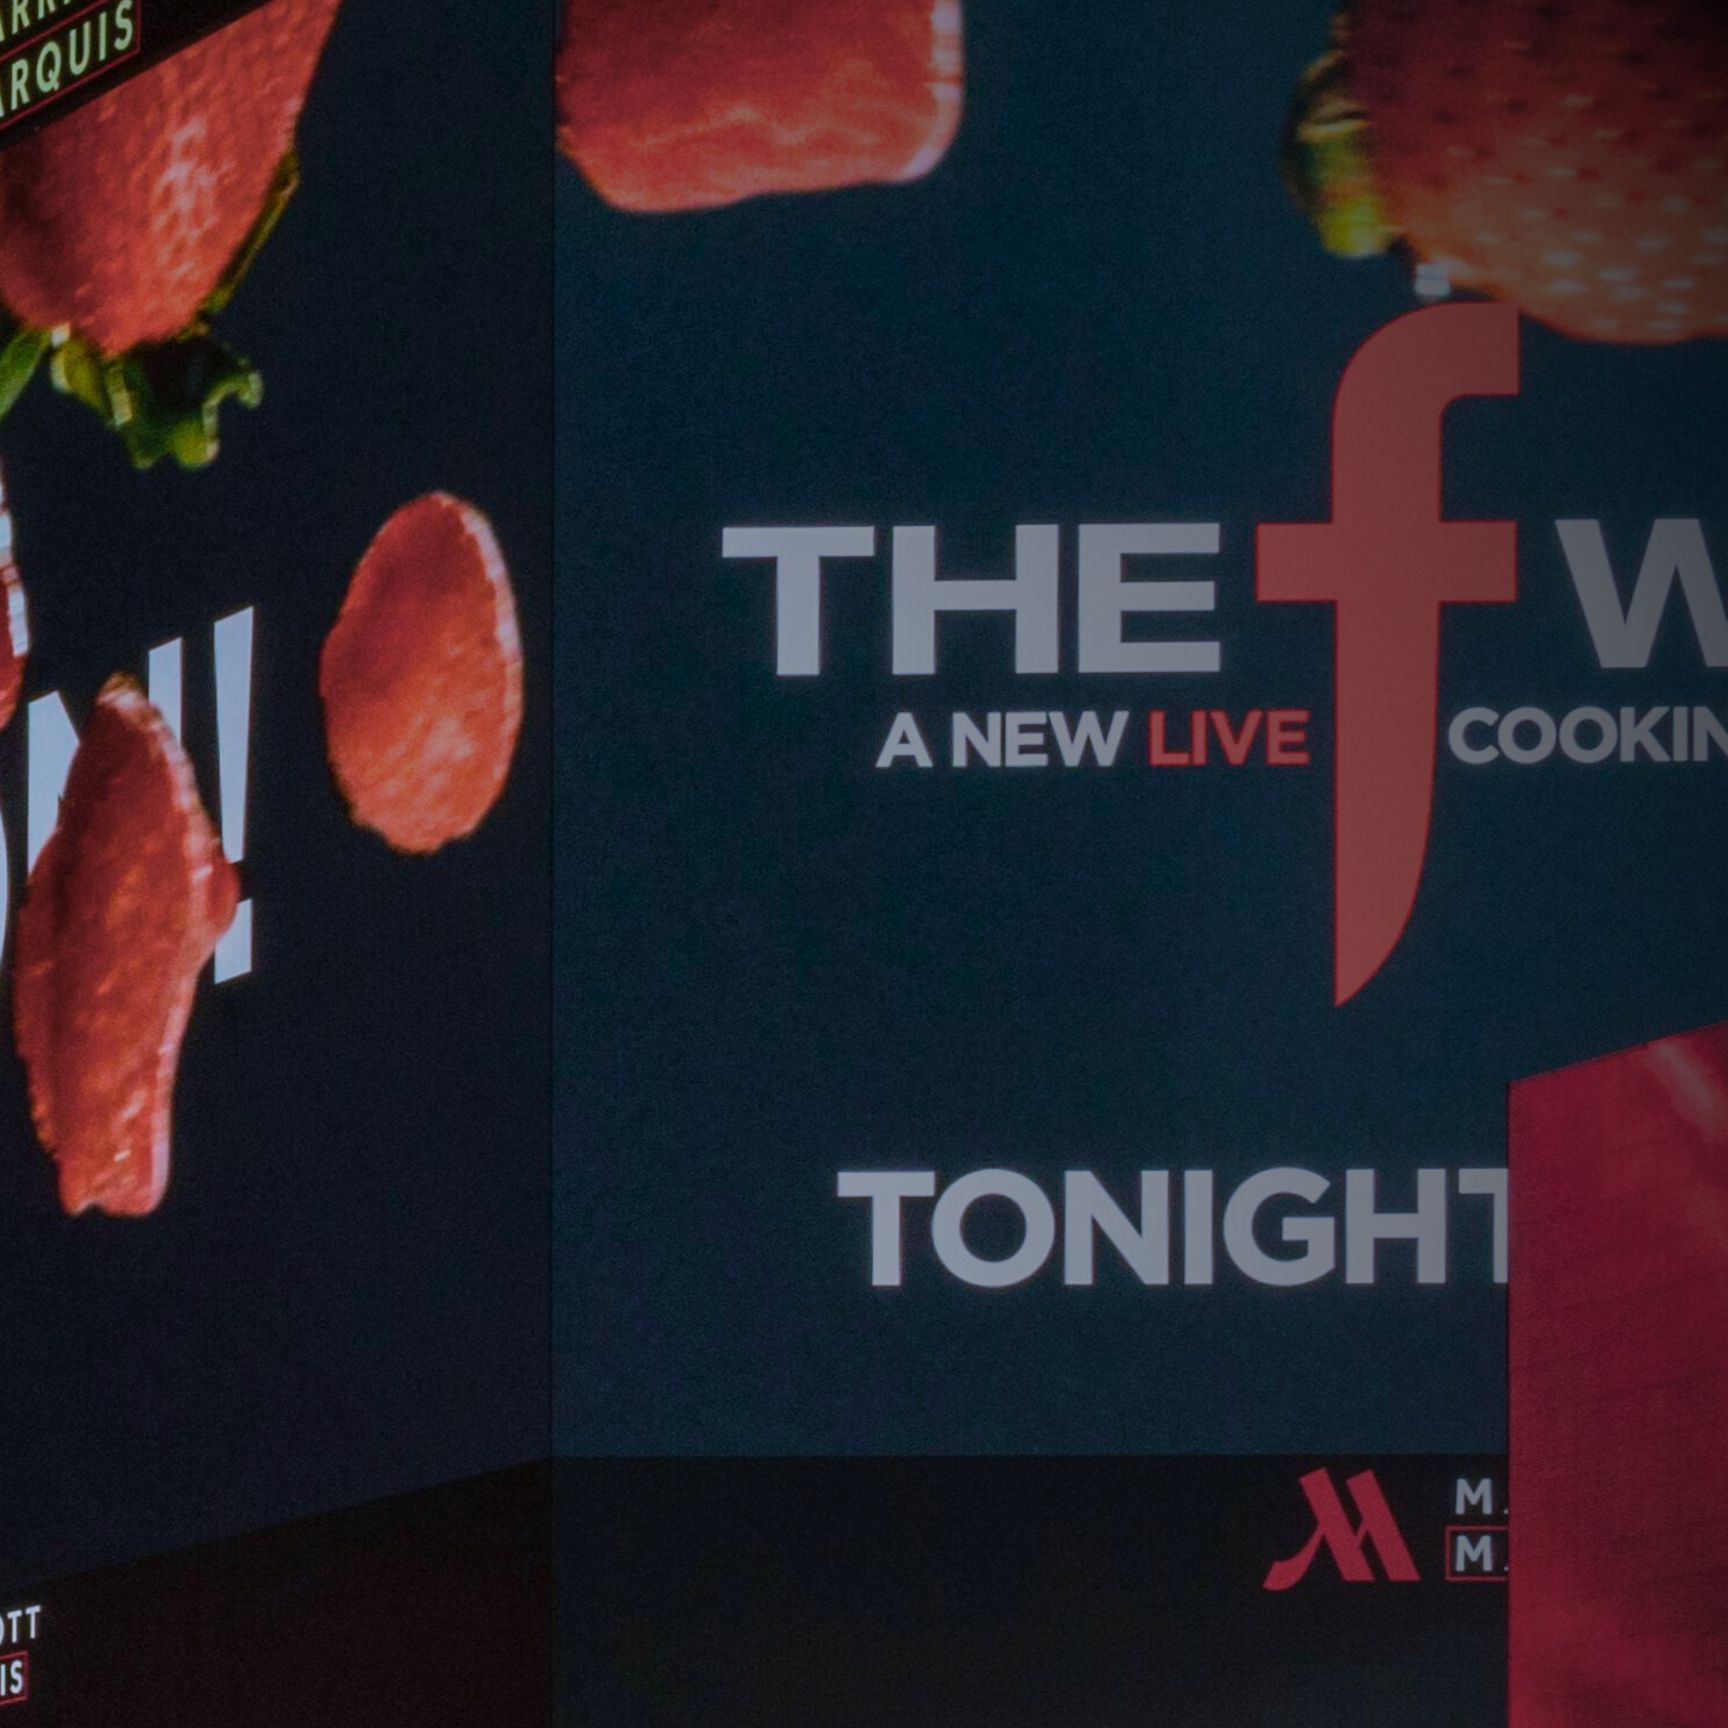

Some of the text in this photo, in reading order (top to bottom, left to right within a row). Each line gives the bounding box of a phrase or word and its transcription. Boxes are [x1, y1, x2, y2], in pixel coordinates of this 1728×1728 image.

[721, 522, 1221, 677] THE
[1255, 302, 1521, 1008] f
[875, 711, 934, 769] A
[952, 710, 1130, 768] NEW
[1148, 708, 1312, 767] LIVE
[836, 1166, 1509, 1290] TONIGHT
